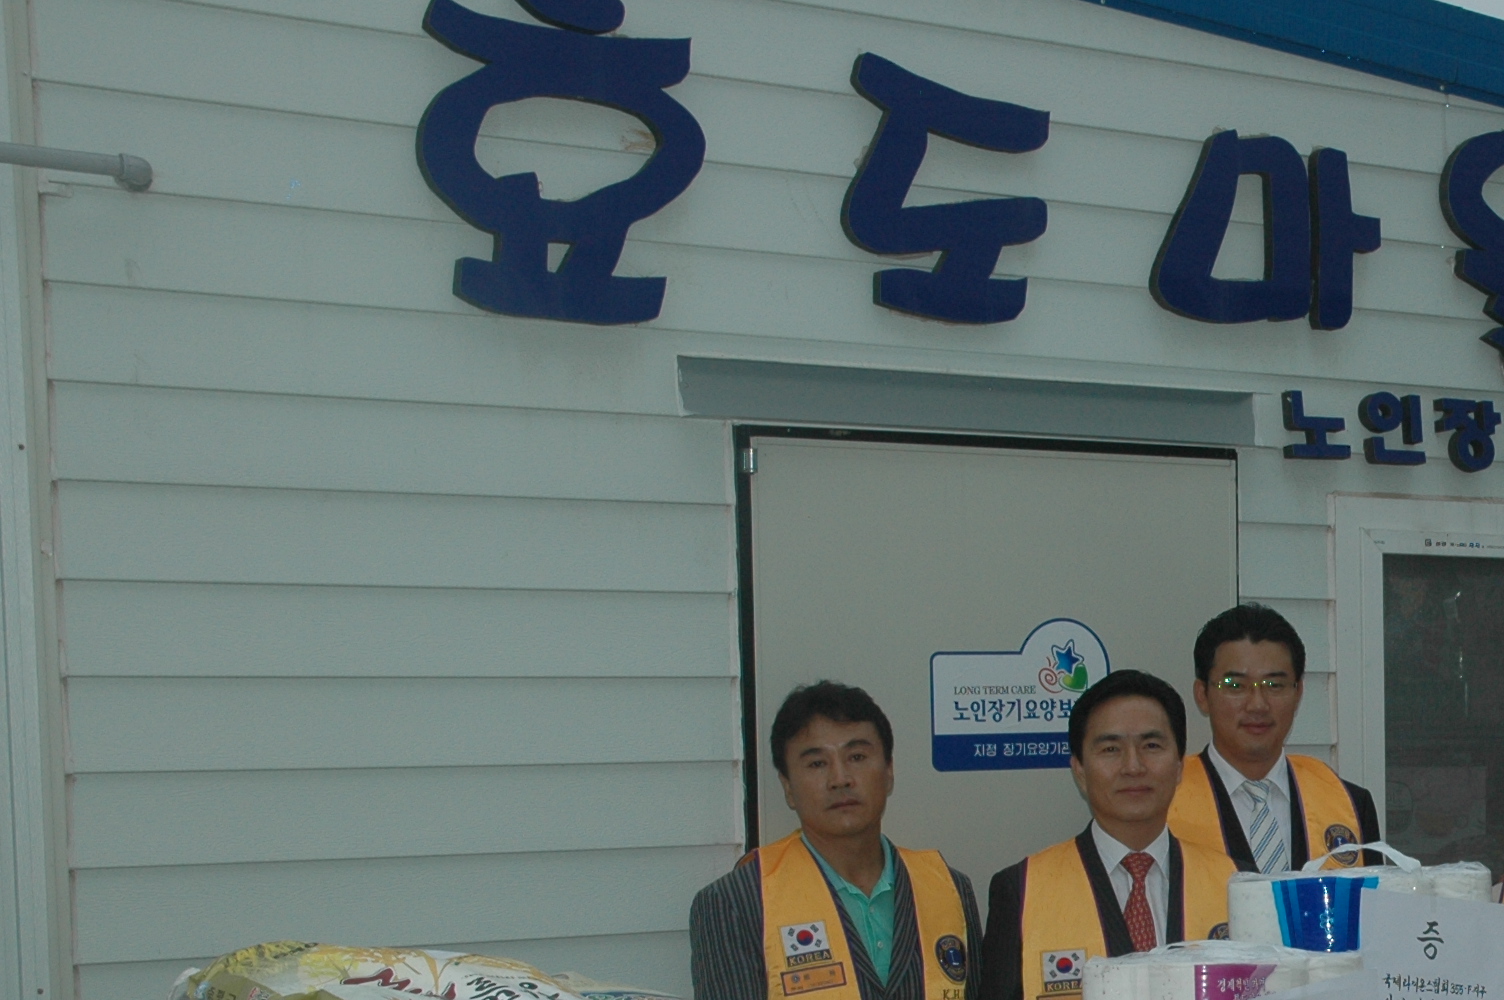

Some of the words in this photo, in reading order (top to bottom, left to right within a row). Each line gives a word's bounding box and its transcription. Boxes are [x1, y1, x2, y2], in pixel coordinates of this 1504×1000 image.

[953, 685, 981, 695] LONG
[983, 685, 1009, 695] TERM
[1010, 684, 1037, 694] CARE
[953, 698, 1079, 722] 노인장기요양보
[973, 743, 997, 758] 지정
[1416, 920, 1444, 961] 증
[787, 949, 832, 967] KOREA
